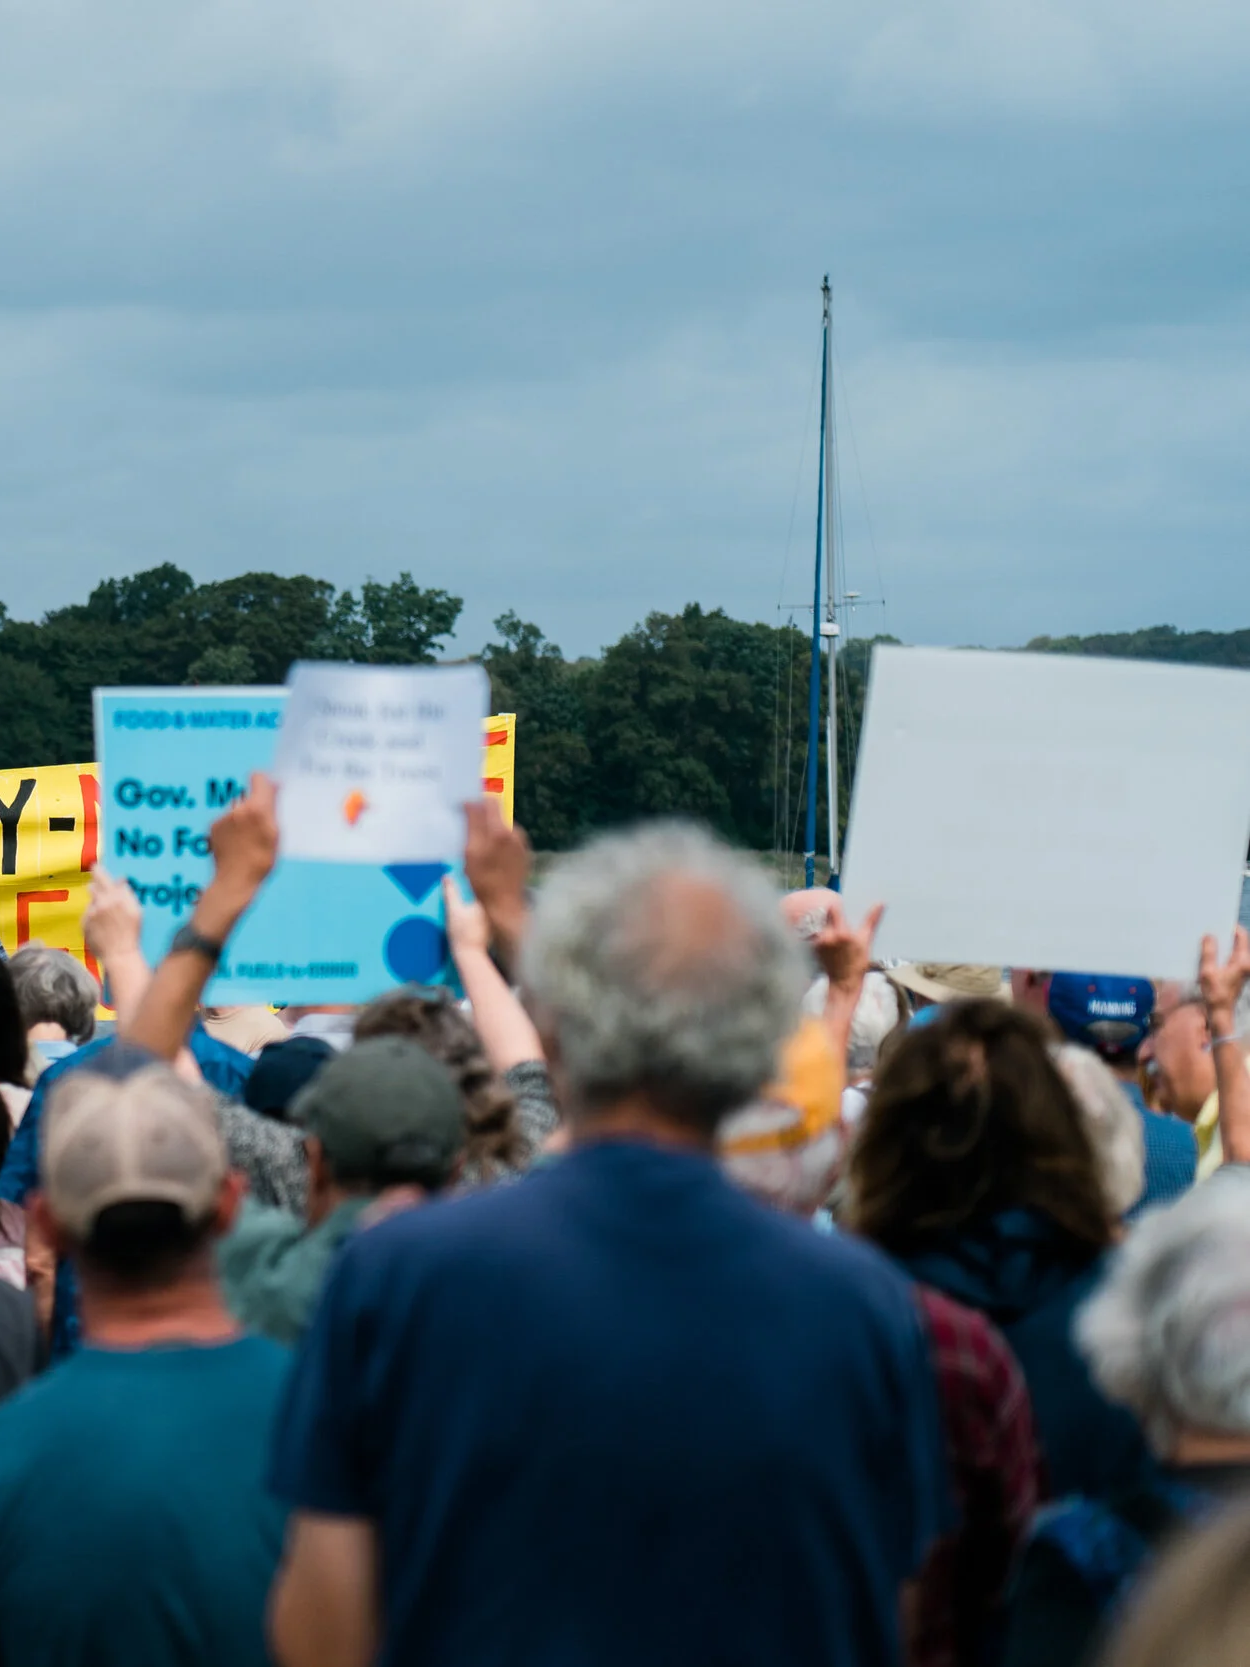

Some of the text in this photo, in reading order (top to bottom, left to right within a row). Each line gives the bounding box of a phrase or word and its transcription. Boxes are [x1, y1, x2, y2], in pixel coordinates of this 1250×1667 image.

[114, 710, 170, 729] FOOD
[189, 710, 251, 729] WATER
[114, 777, 196, 810] Gov.
[116, 827, 213, 858] No Fo
